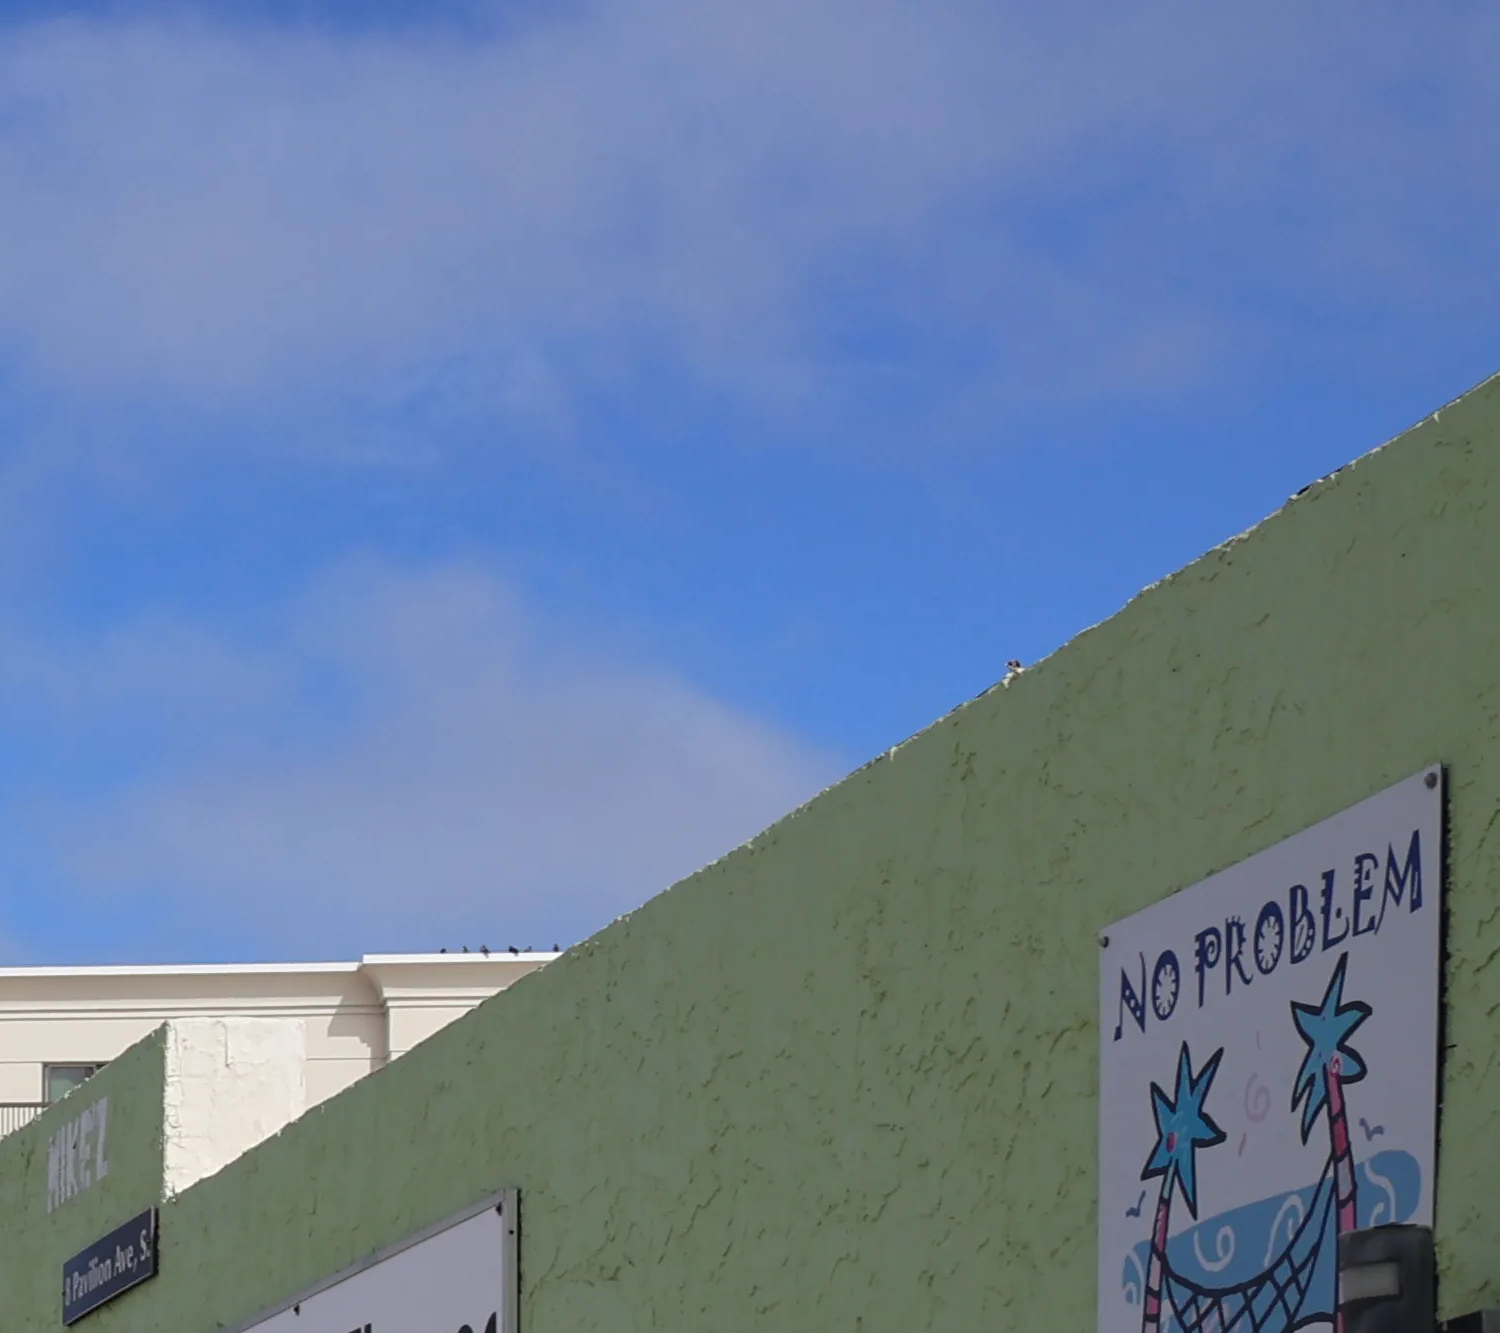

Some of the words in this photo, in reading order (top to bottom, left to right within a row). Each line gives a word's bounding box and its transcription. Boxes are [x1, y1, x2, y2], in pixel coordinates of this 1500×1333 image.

[1114, 947, 1181, 1041] NO
[1194, 828, 1424, 1008] PROBLEM
[72, 1256, 113, 1301] Pavilion
[113, 1244, 139, 1273] Ave,
